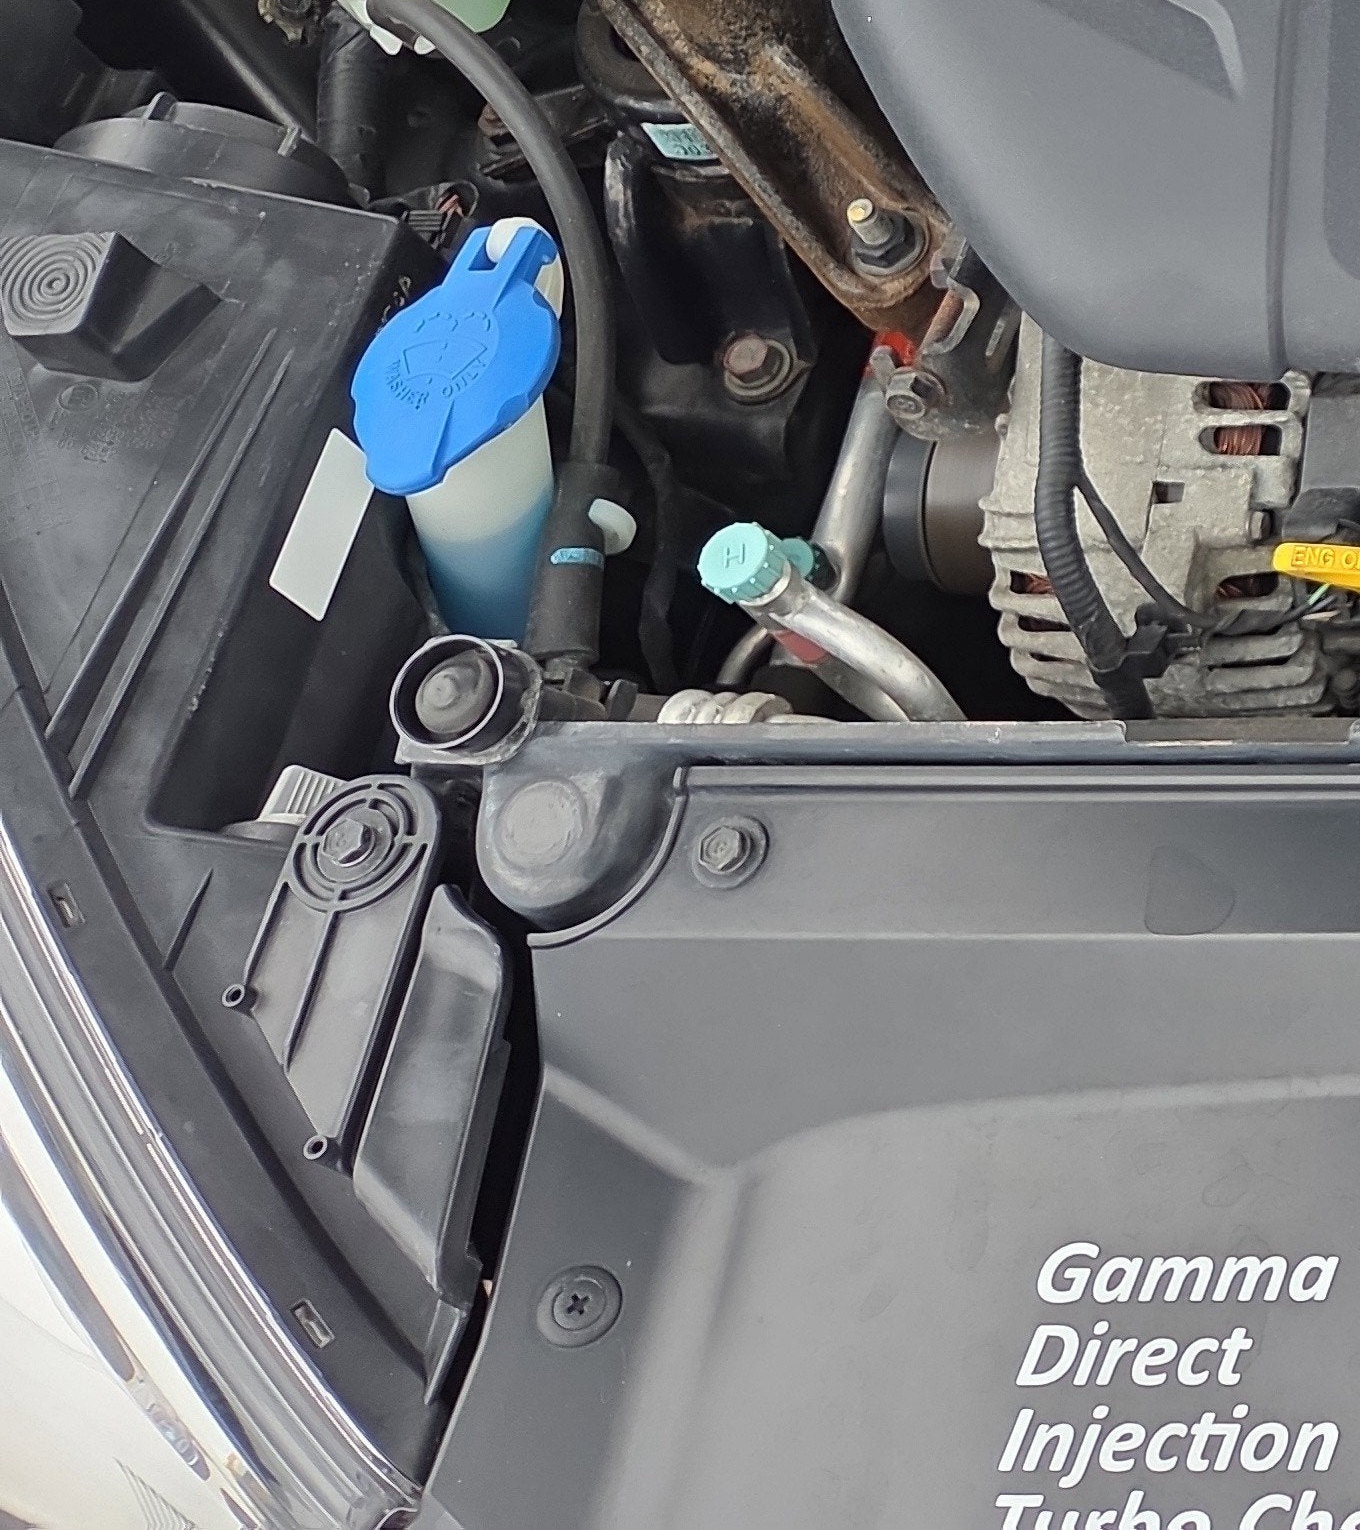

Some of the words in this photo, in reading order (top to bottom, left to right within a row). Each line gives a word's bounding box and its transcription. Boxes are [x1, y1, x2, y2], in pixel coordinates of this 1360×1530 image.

[725, 543, 746, 569] H
[1291, 546, 1337, 568] ENG
[1034, 1240, 1342, 1306] Gamma
[1012, 1319, 1255, 1388] Direct
[994, 1403, 1341, 1489] Injection
